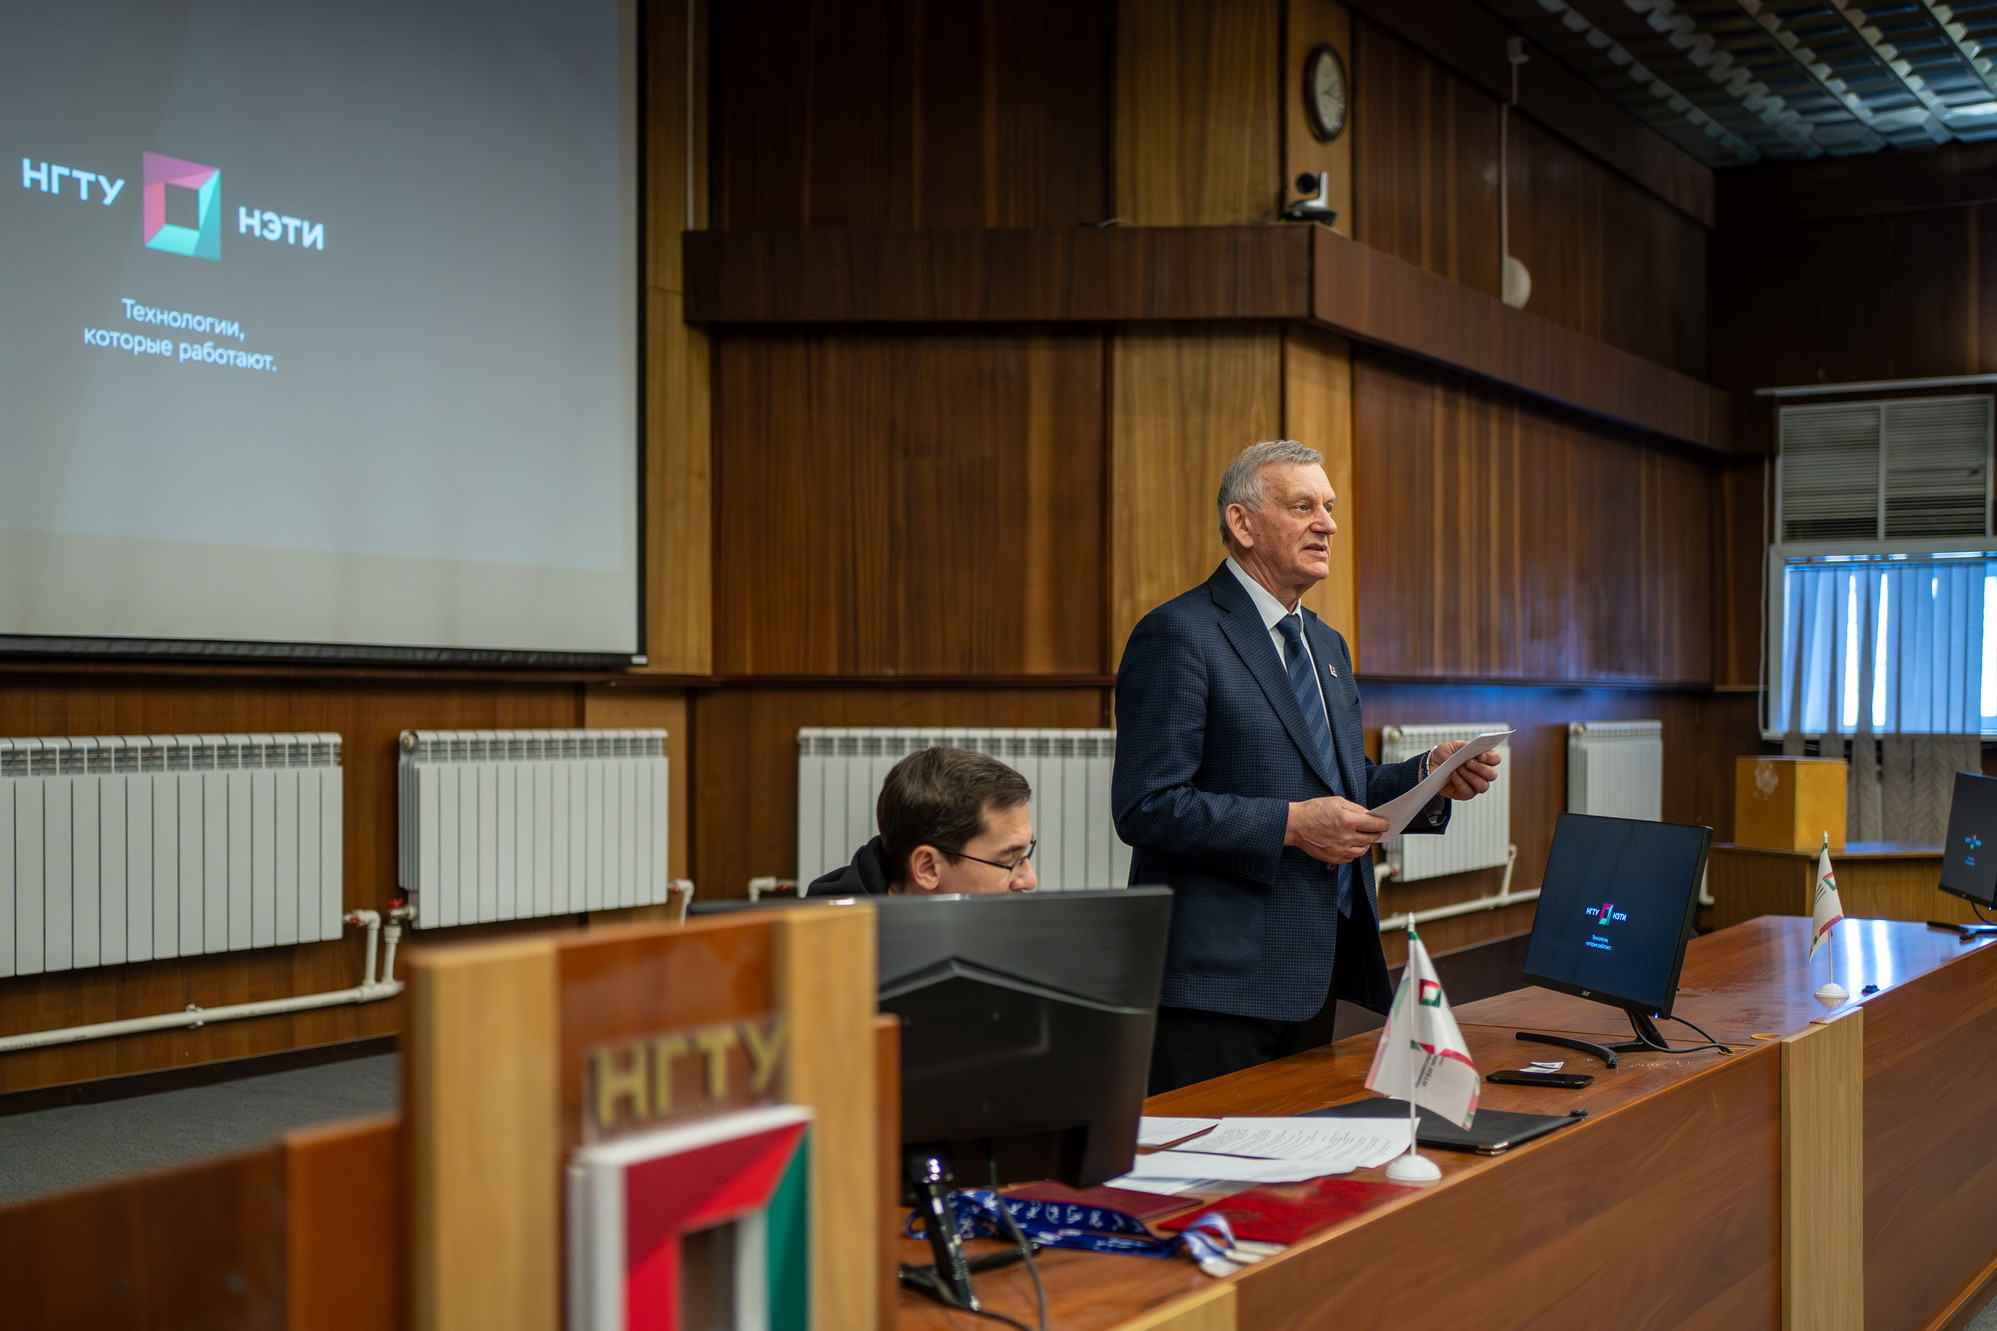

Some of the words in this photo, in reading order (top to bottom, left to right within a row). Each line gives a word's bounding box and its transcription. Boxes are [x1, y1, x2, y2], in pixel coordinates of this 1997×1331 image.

[22, 157, 126, 206] НГТУ
[238, 205, 325, 251] НЭТИ
[84, 327, 173, 356] которые
[179, 340, 278, 372] работают.
[121, 297, 246, 342] Технологии,
[595, 1014, 789, 1128] НГТУ
